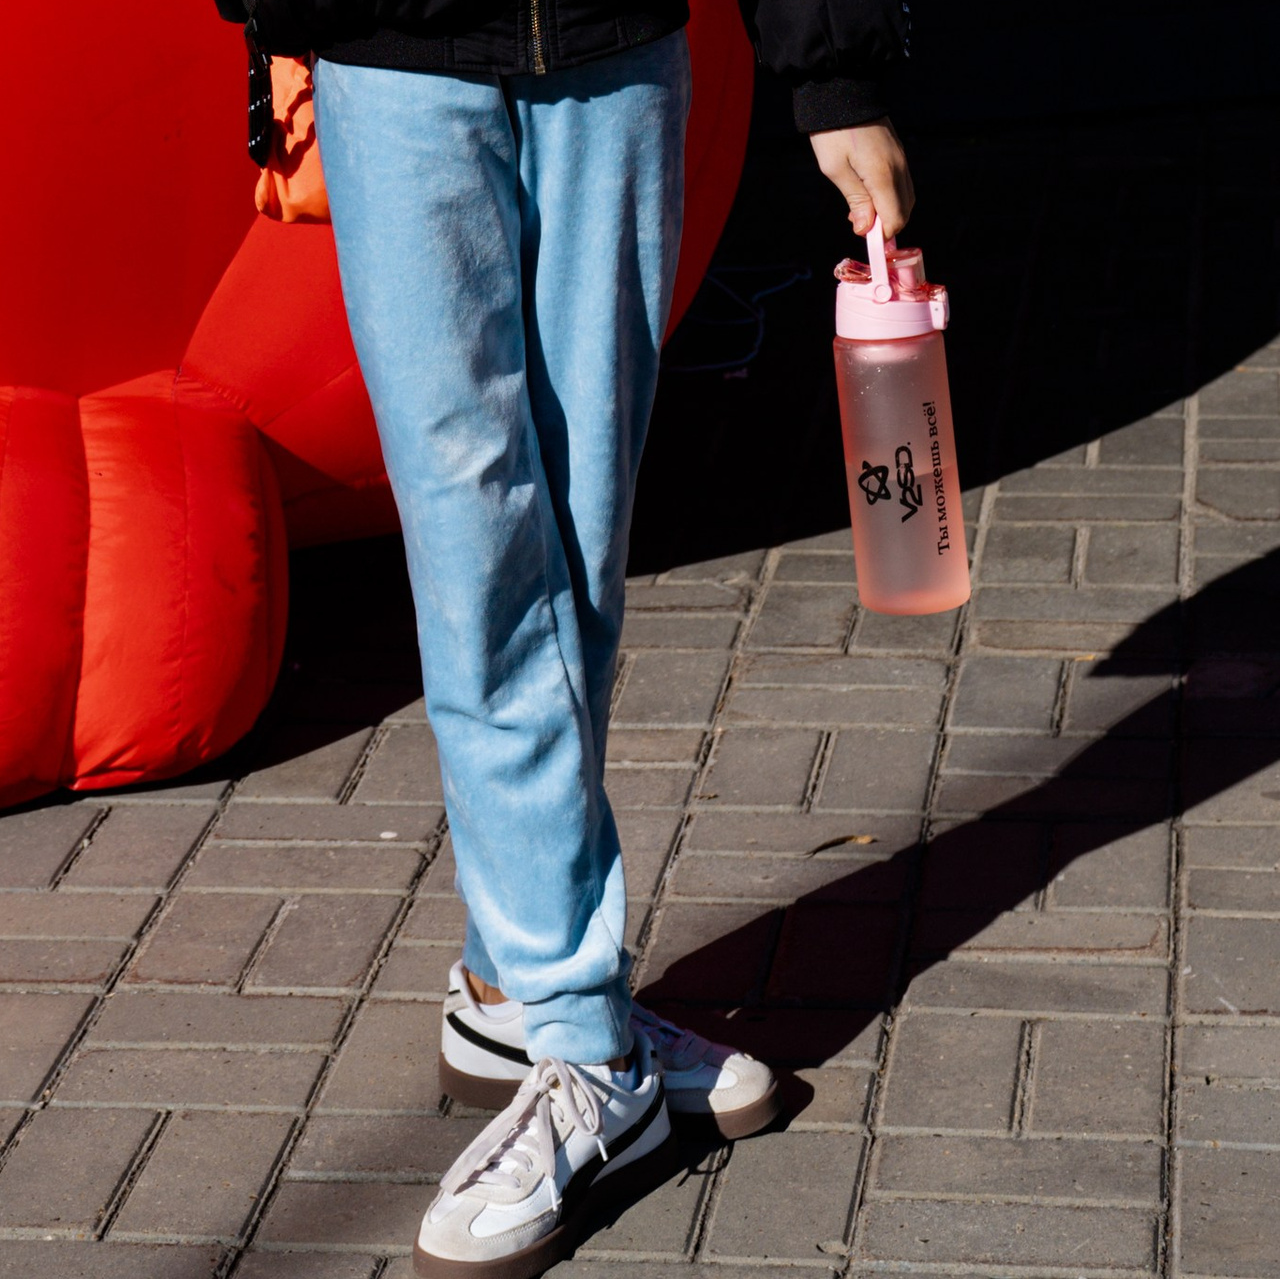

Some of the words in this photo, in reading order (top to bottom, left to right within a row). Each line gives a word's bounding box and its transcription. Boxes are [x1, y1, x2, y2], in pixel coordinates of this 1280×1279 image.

[922, 400, 938, 438] всё!
[930, 440, 948, 523] можешь
[937, 524, 950, 556] Ты
